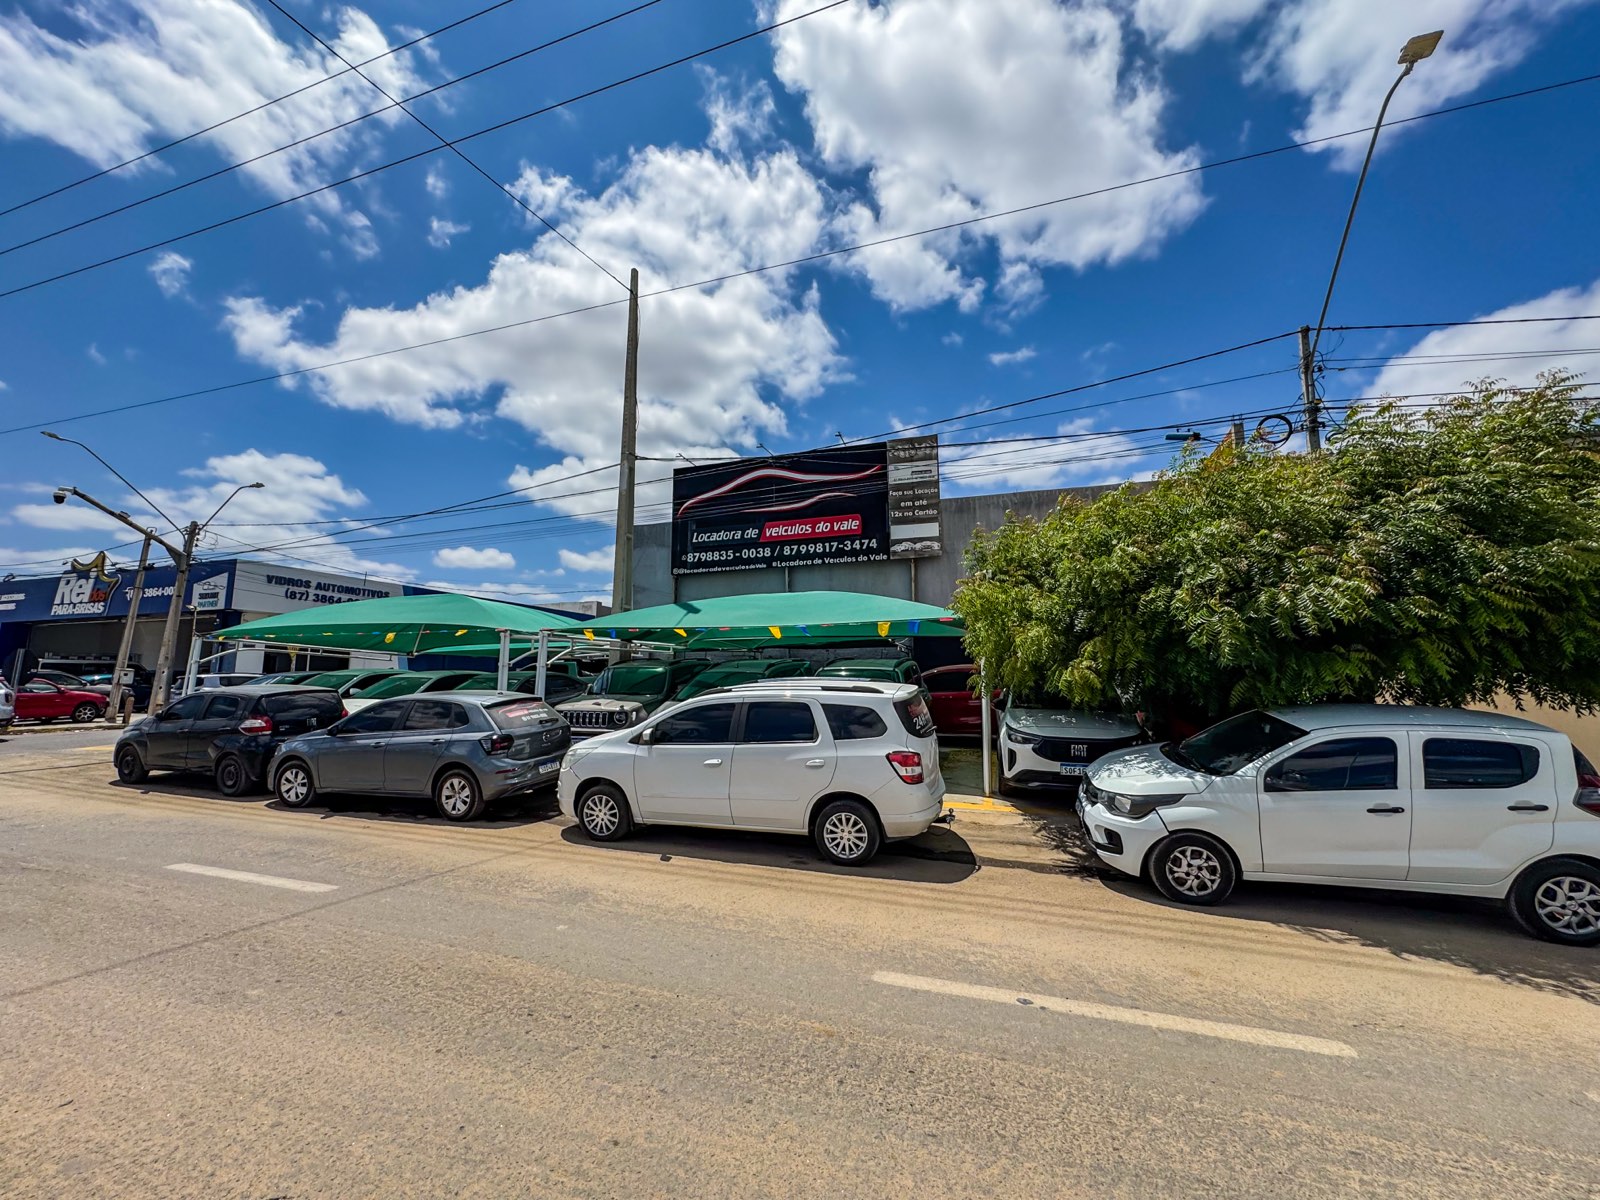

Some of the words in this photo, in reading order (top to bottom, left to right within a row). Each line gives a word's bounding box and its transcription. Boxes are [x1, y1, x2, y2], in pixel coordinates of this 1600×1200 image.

[914, 498, 928, 506] até
[692, 530, 742, 543] Locadora
[743, 527, 759, 539] de
[765, 523, 812, 537] veiculos
[815, 521, 831, 533] do
[833, 518, 859, 531] vale
[686, 547, 772, 563] 8798835-0038
[783, 538, 878, 556] 8799817-3474
[777, 558, 812, 567] Locadora
[813, 557, 823, 565] de
[857, 554, 868, 562] do
[869, 553, 888, 561] Vale
[54, 567, 98, 604] Rei
[266, 574, 312, 589] VIDROS
[314, 582, 390, 599] AUTOMOTIVOS
[284, 587, 309, 602] (87)
[50, 602, 105, 616] PARA-BRISAS
[1070, 744, 1088, 757] FIAT
